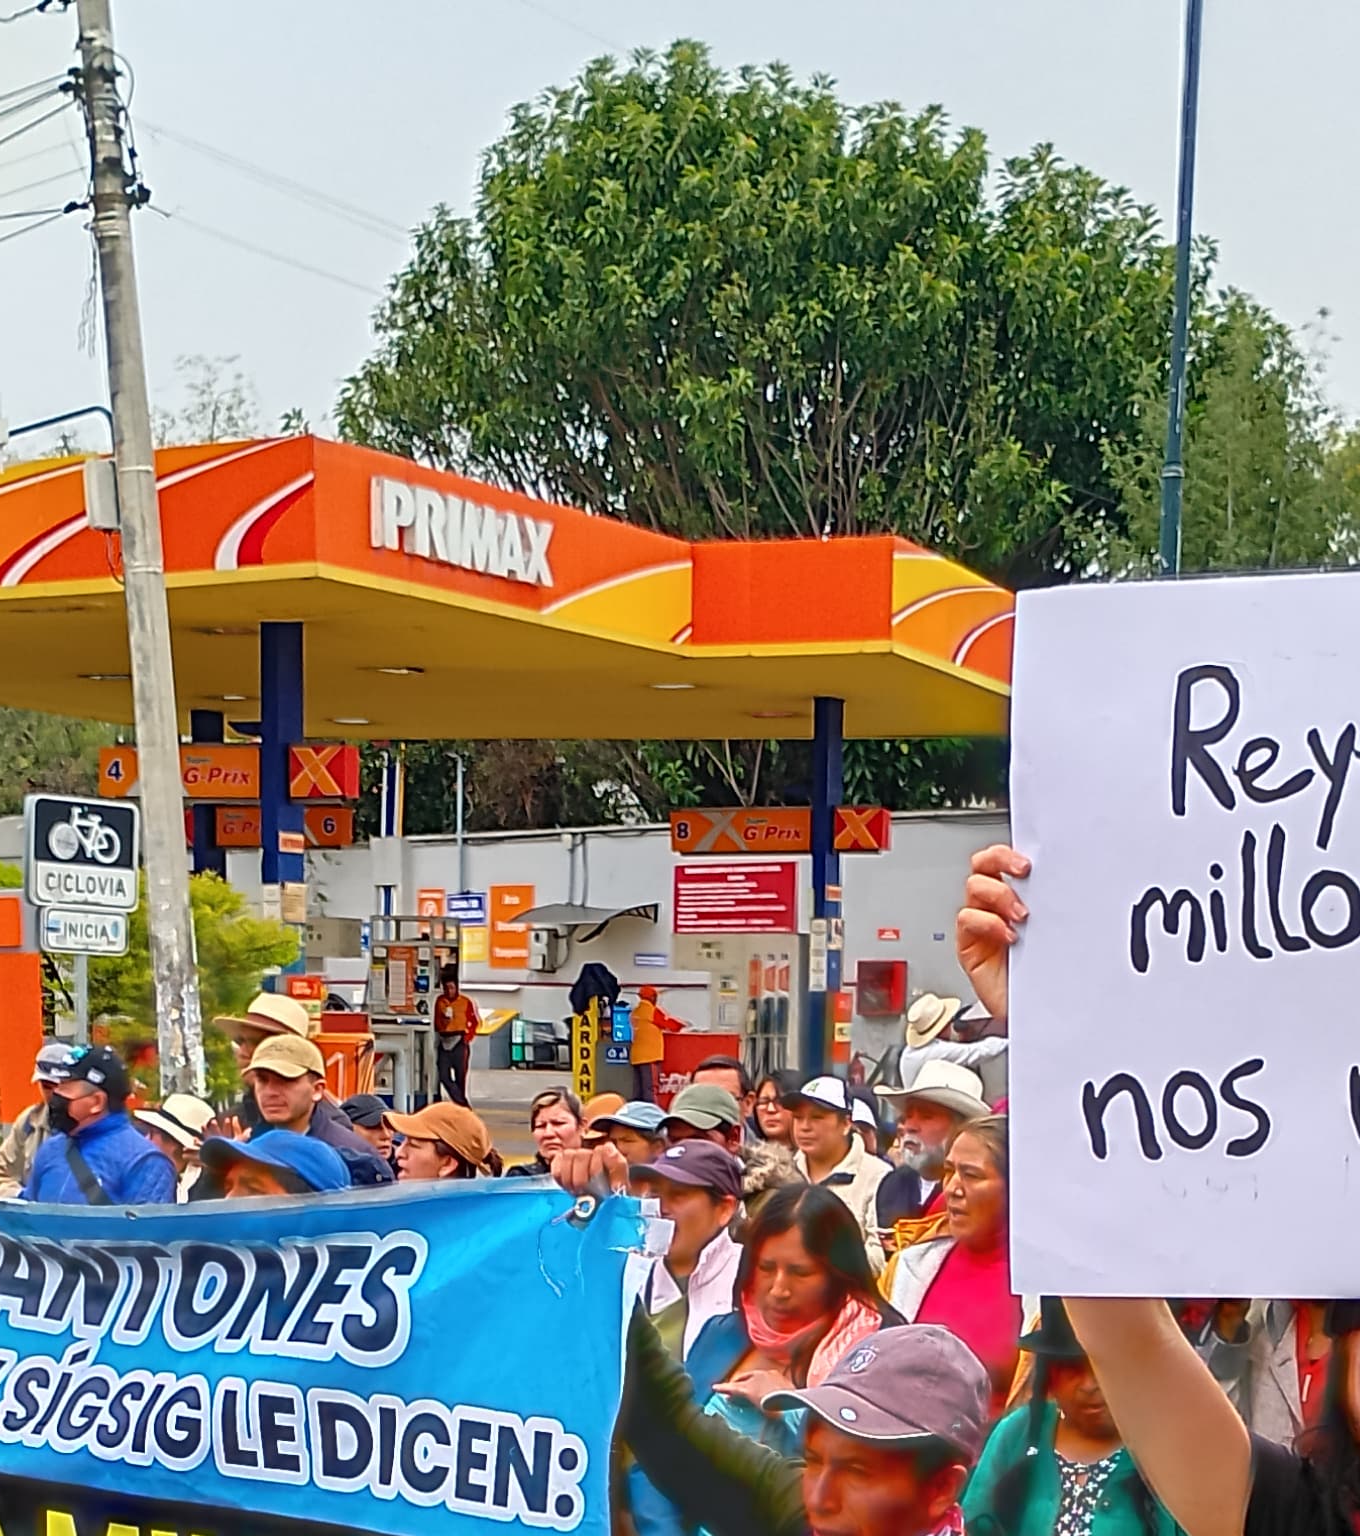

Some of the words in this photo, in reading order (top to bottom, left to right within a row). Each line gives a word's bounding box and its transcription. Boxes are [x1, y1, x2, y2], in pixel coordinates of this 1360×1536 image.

[370, 475, 555, 588] PRIMAX
[107, 760, 122, 781] 4
[321, 816, 335, 835] 6
[675, 822, 689, 839] 8
[44, 871, 127, 898] CICLOVIA
[63, 921, 111, 942] INICIA
[1081, 1057, 1272, 1161] nos
[2, 1347, 203, 1461] SÍGSIG
[220, 1388, 302, 1474] LE
[316, 1400, 579, 1519] DICEN:
